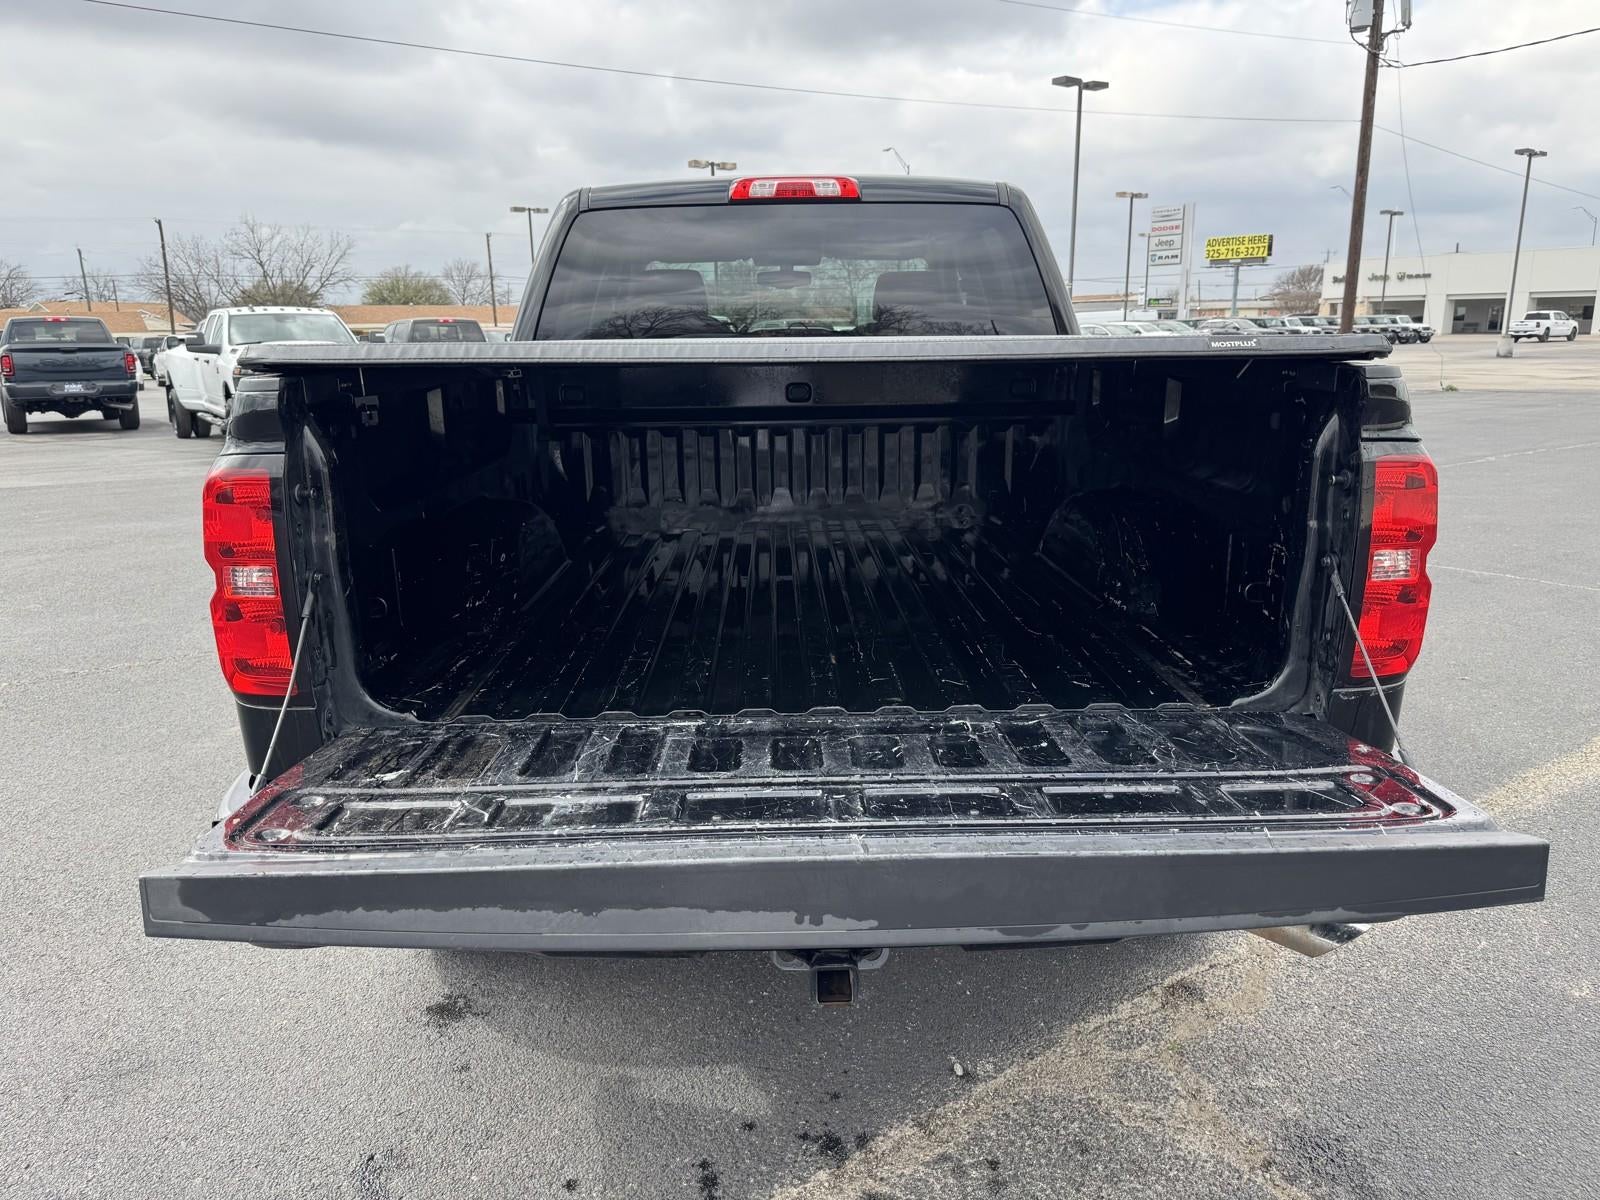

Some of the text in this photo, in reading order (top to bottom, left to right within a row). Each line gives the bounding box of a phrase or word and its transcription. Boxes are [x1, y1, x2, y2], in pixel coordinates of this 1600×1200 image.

[1152, 224, 1180, 232] DODGE
[1155, 239, 1175, 247] Jeep
[1206, 235, 1268, 248] ADVERTISE HERE
[1205, 246, 1266, 258] 325-716-3277
[1211, 340, 1256, 348] MOSTPLUS
